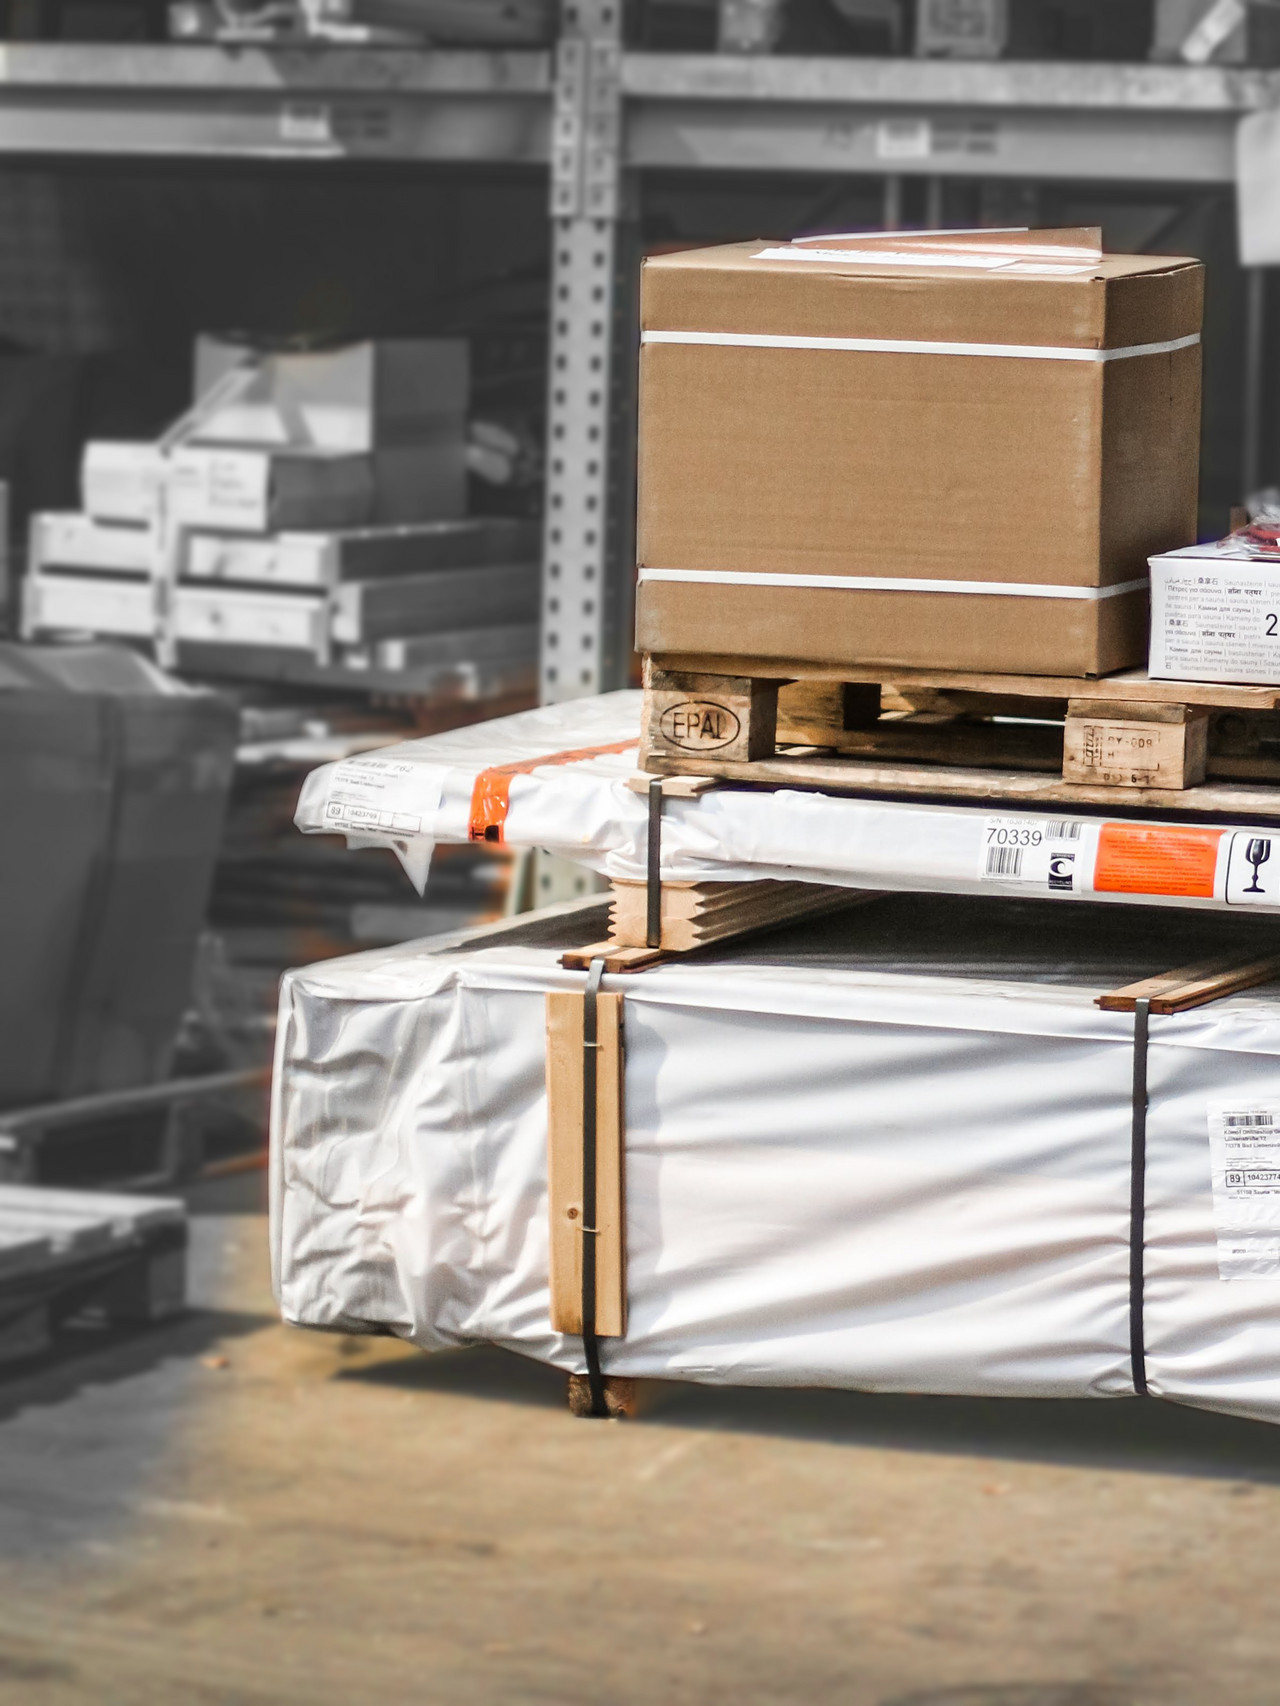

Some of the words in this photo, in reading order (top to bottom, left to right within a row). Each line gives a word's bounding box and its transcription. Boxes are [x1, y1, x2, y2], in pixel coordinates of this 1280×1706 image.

[673, 711, 727, 740] EPAL
[986, 827, 1043, 847] 70339
[1229, 1174, 1241, 1183] 89
